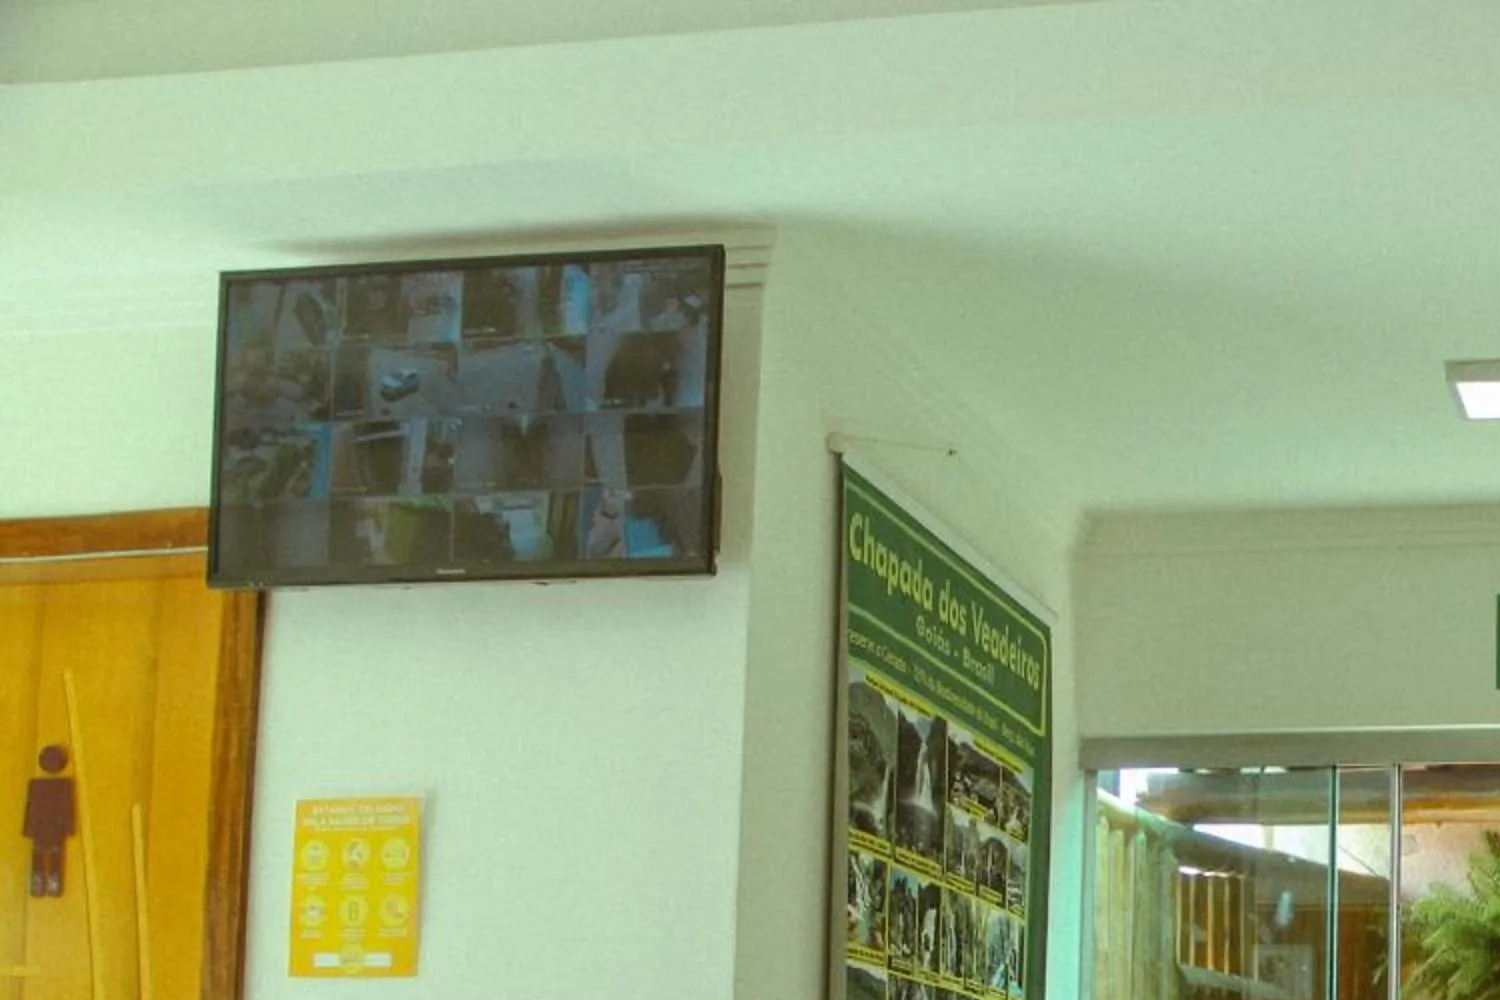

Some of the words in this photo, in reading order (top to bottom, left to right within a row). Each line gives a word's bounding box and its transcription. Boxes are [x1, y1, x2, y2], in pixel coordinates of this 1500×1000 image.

[850, 512, 933, 612] Chapada
[938, 579, 967, 635] dos
[971, 601, 1041, 691] Veadeiros
